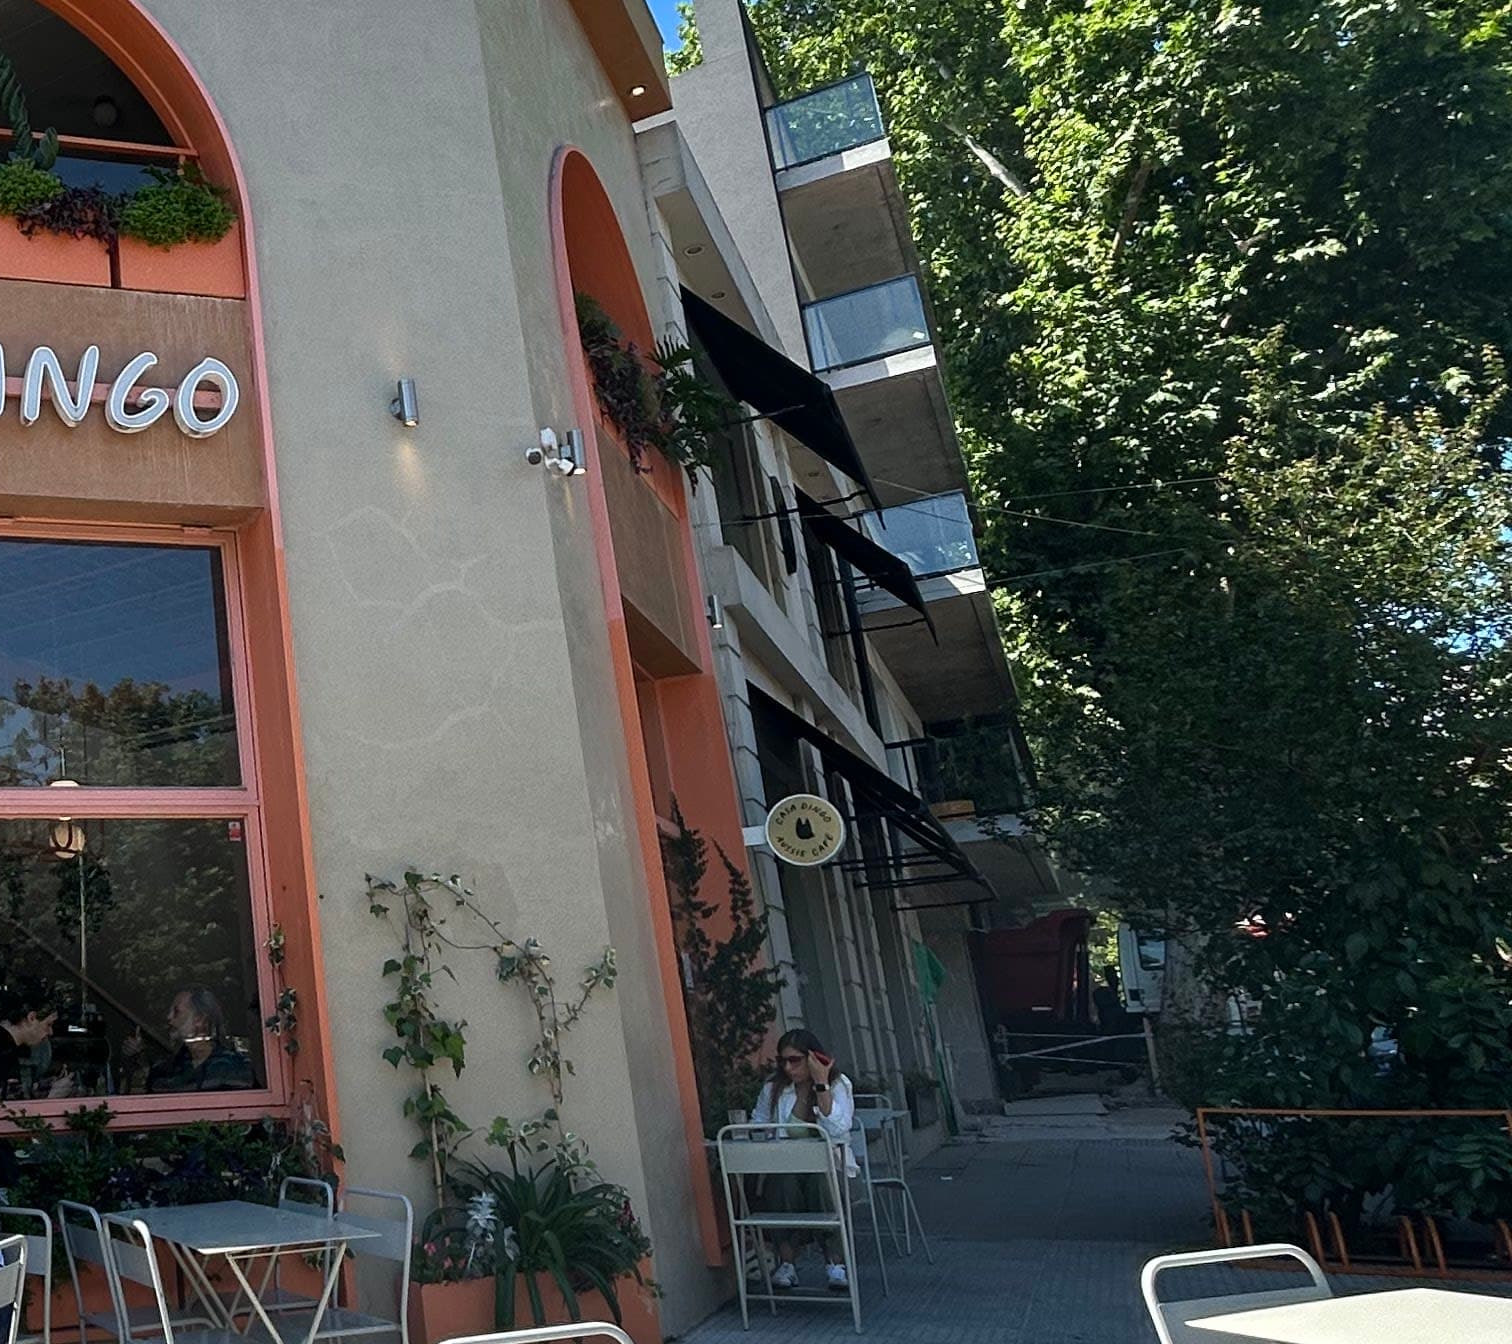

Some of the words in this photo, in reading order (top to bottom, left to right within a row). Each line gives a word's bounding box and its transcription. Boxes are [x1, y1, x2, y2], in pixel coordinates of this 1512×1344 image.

[775, 804, 797, 825] CASA
[801, 802, 832, 823] DINGO
[776, 836, 806, 857] AUSSIE
